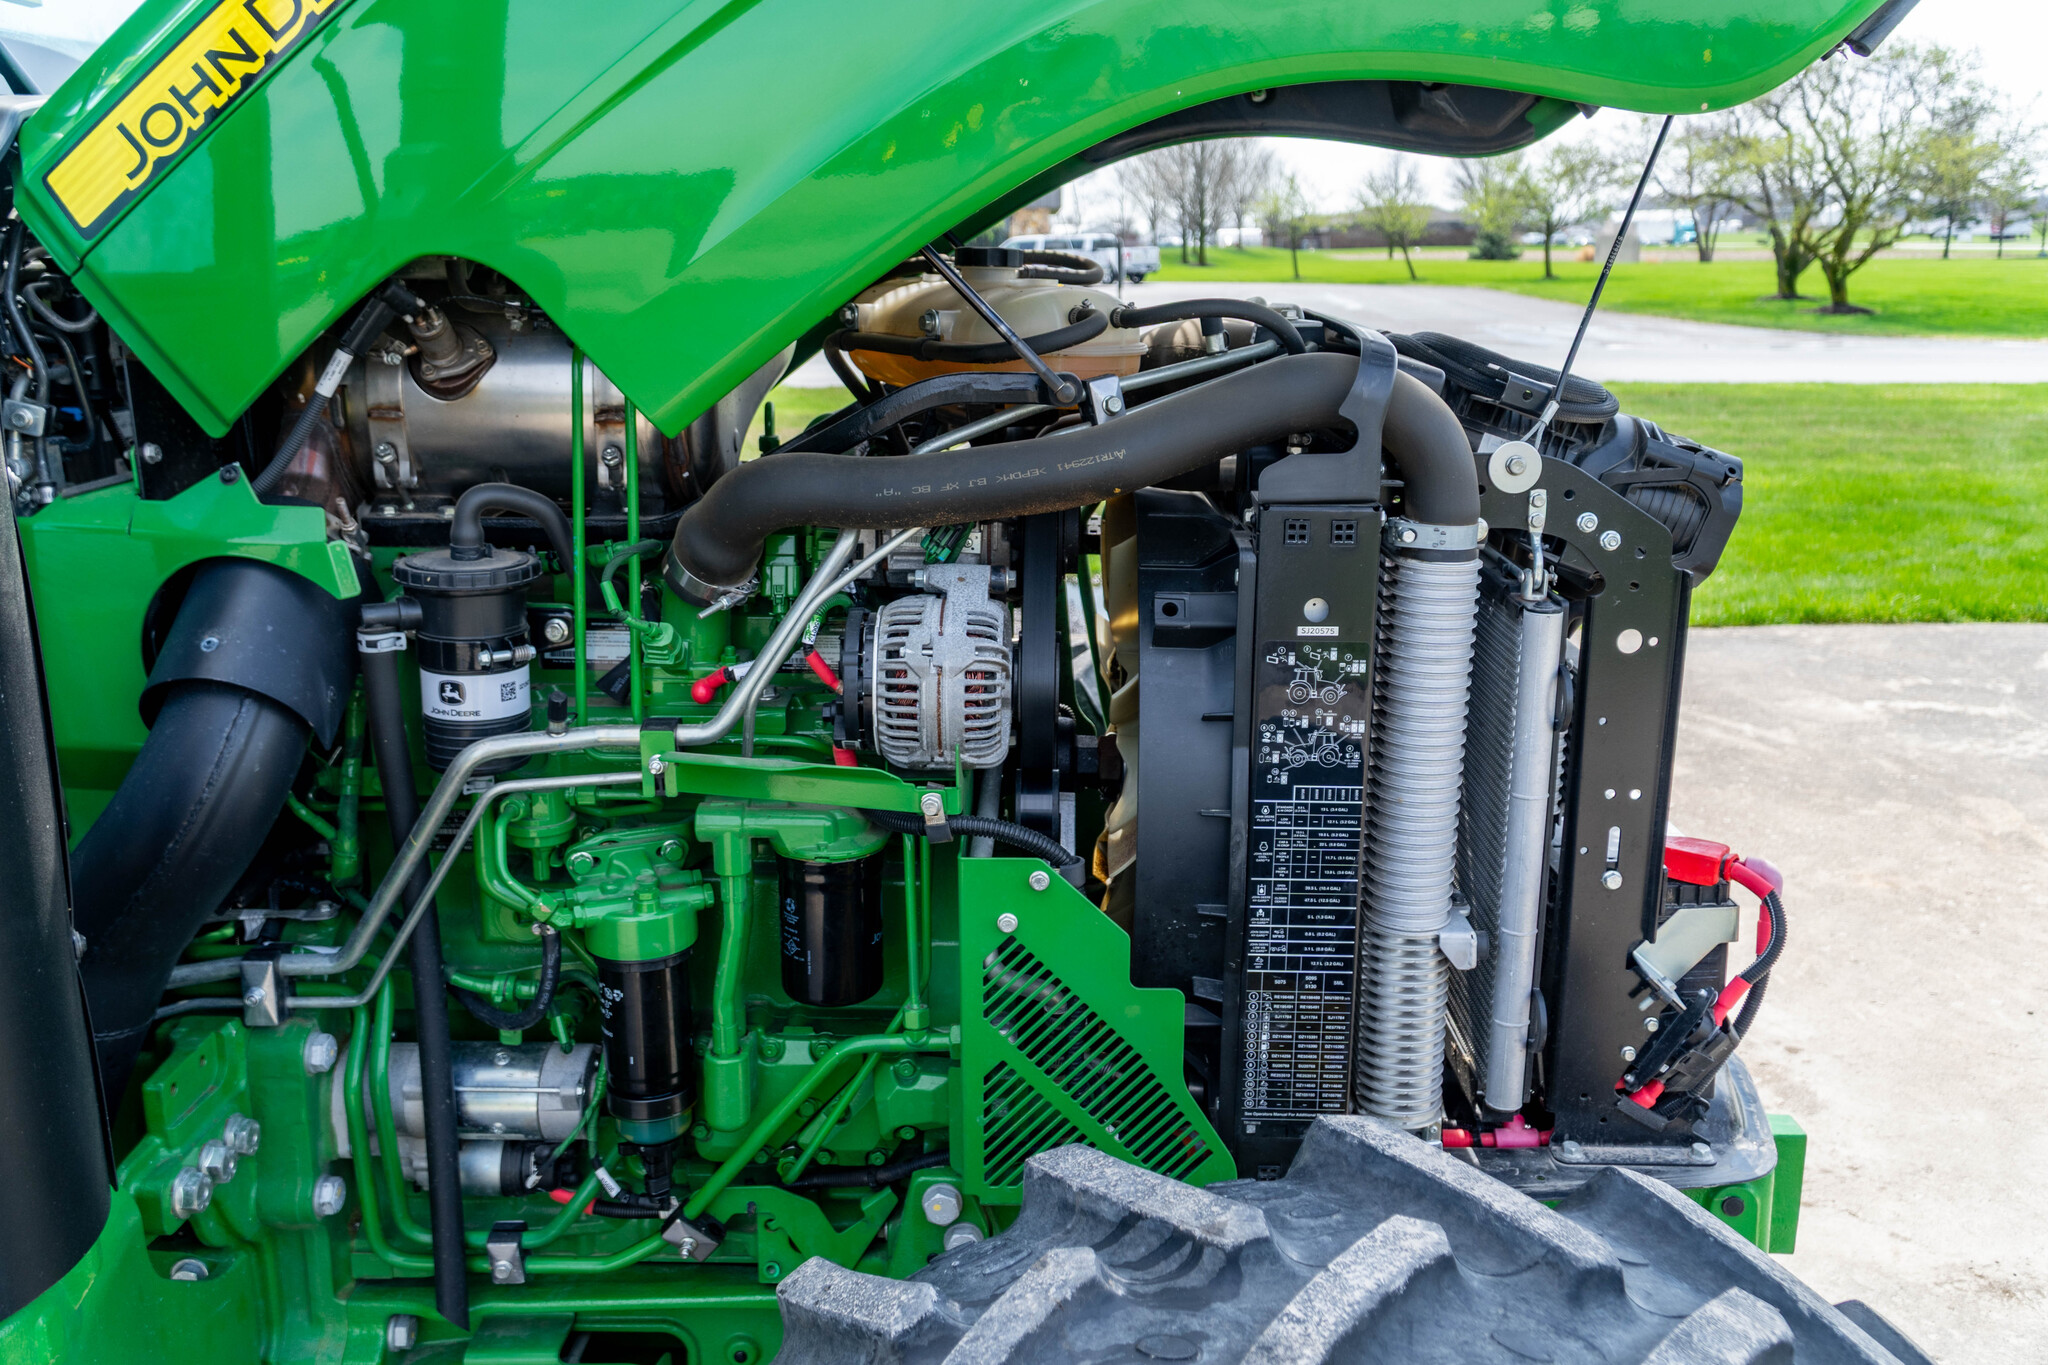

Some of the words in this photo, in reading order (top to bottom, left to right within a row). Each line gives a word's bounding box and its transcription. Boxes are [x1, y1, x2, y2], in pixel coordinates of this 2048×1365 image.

[116, 27, 261, 181] JOHN
[968, 477, 986, 488] BJ
[911, 484, 930, 494] BC
[431, 707, 450, 717] JOHN
